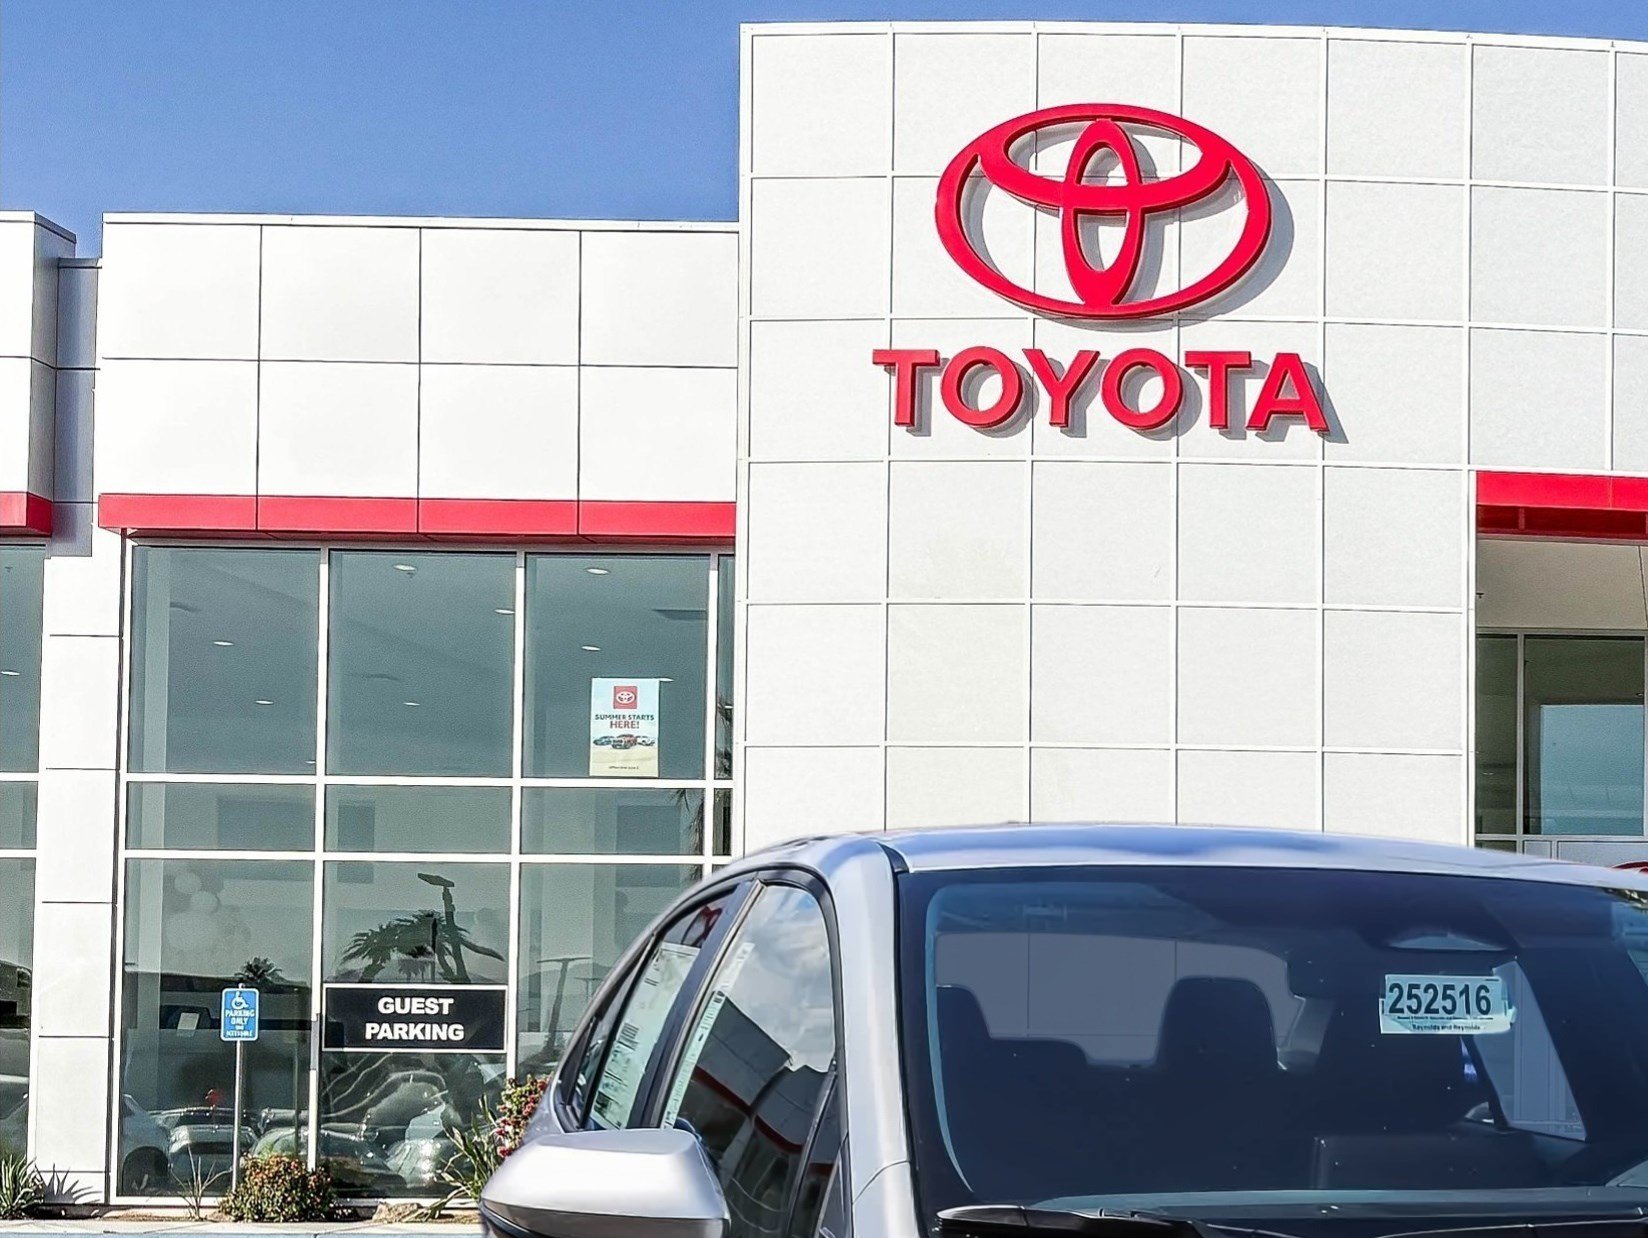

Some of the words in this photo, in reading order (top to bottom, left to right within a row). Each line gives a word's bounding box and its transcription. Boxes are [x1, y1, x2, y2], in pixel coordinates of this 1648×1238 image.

[872, 346, 1331, 434] TOYOTA
[609, 720, 640, 729] HERE!
[377, 996, 455, 1015] GUEST
[1388, 982, 1492, 1016] 252516
[225, 1009, 255, 1018] PARKING
[230, 1016, 249, 1025] ONLY
[364, 1022, 465, 1041] PARKING
